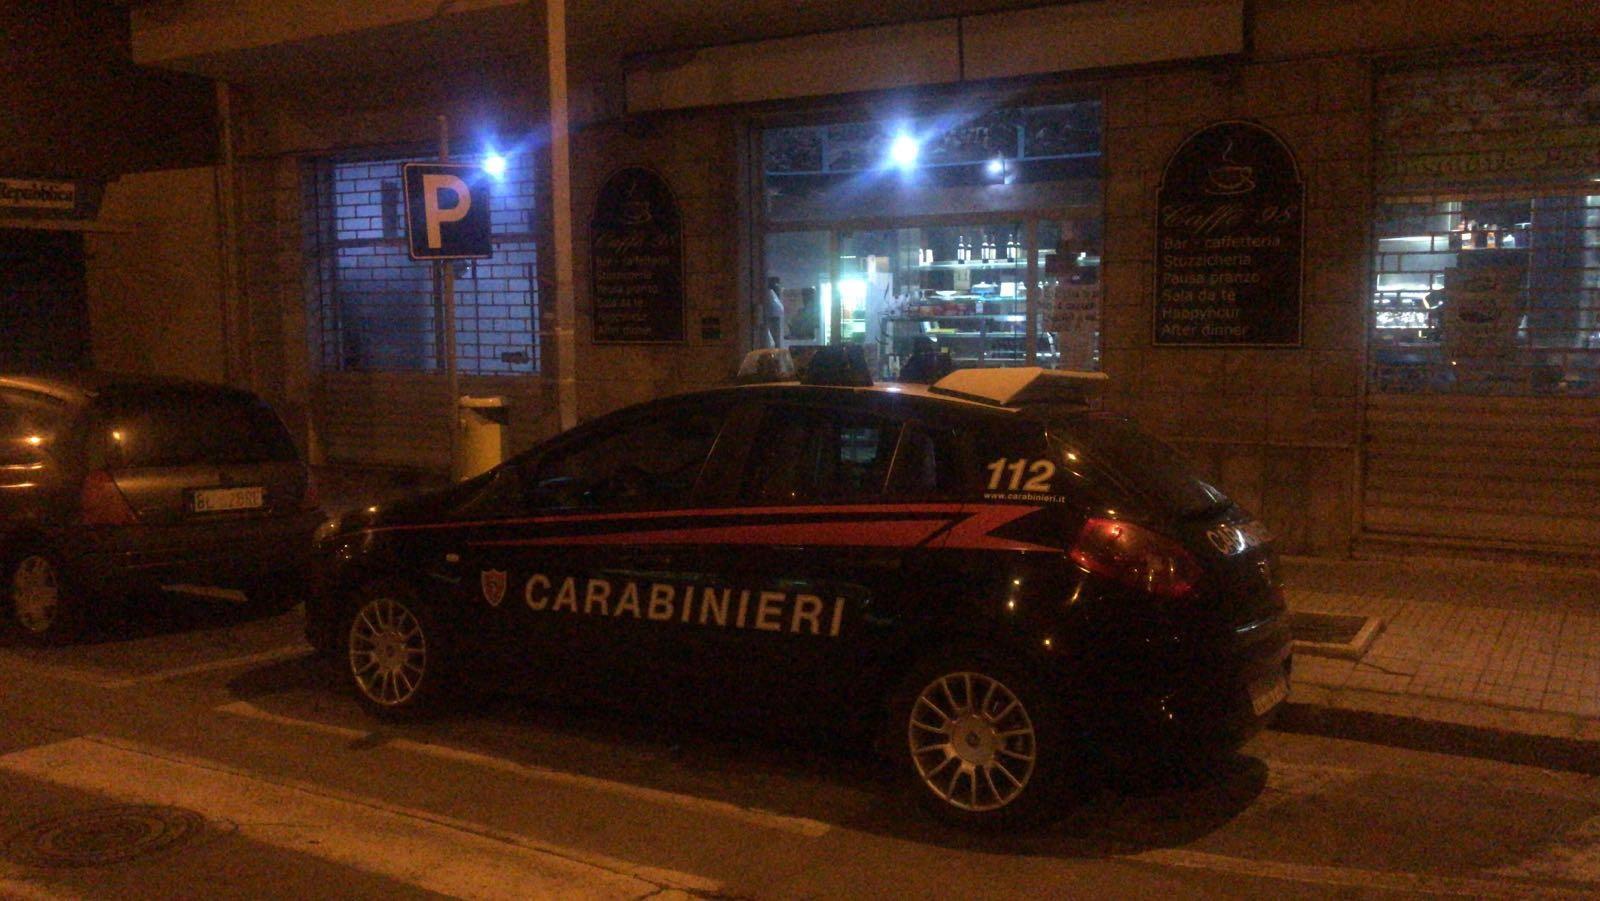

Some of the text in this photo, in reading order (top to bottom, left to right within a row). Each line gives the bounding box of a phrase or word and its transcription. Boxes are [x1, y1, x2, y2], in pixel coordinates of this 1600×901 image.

[422, 174, 472, 249] P
[1162, 272, 1206, 285] Pausa
[987, 458, 1056, 492] 112
[984, 492, 1066, 504] www.carabinieri.it
[524, 573, 847, 637] CARABINIERI
